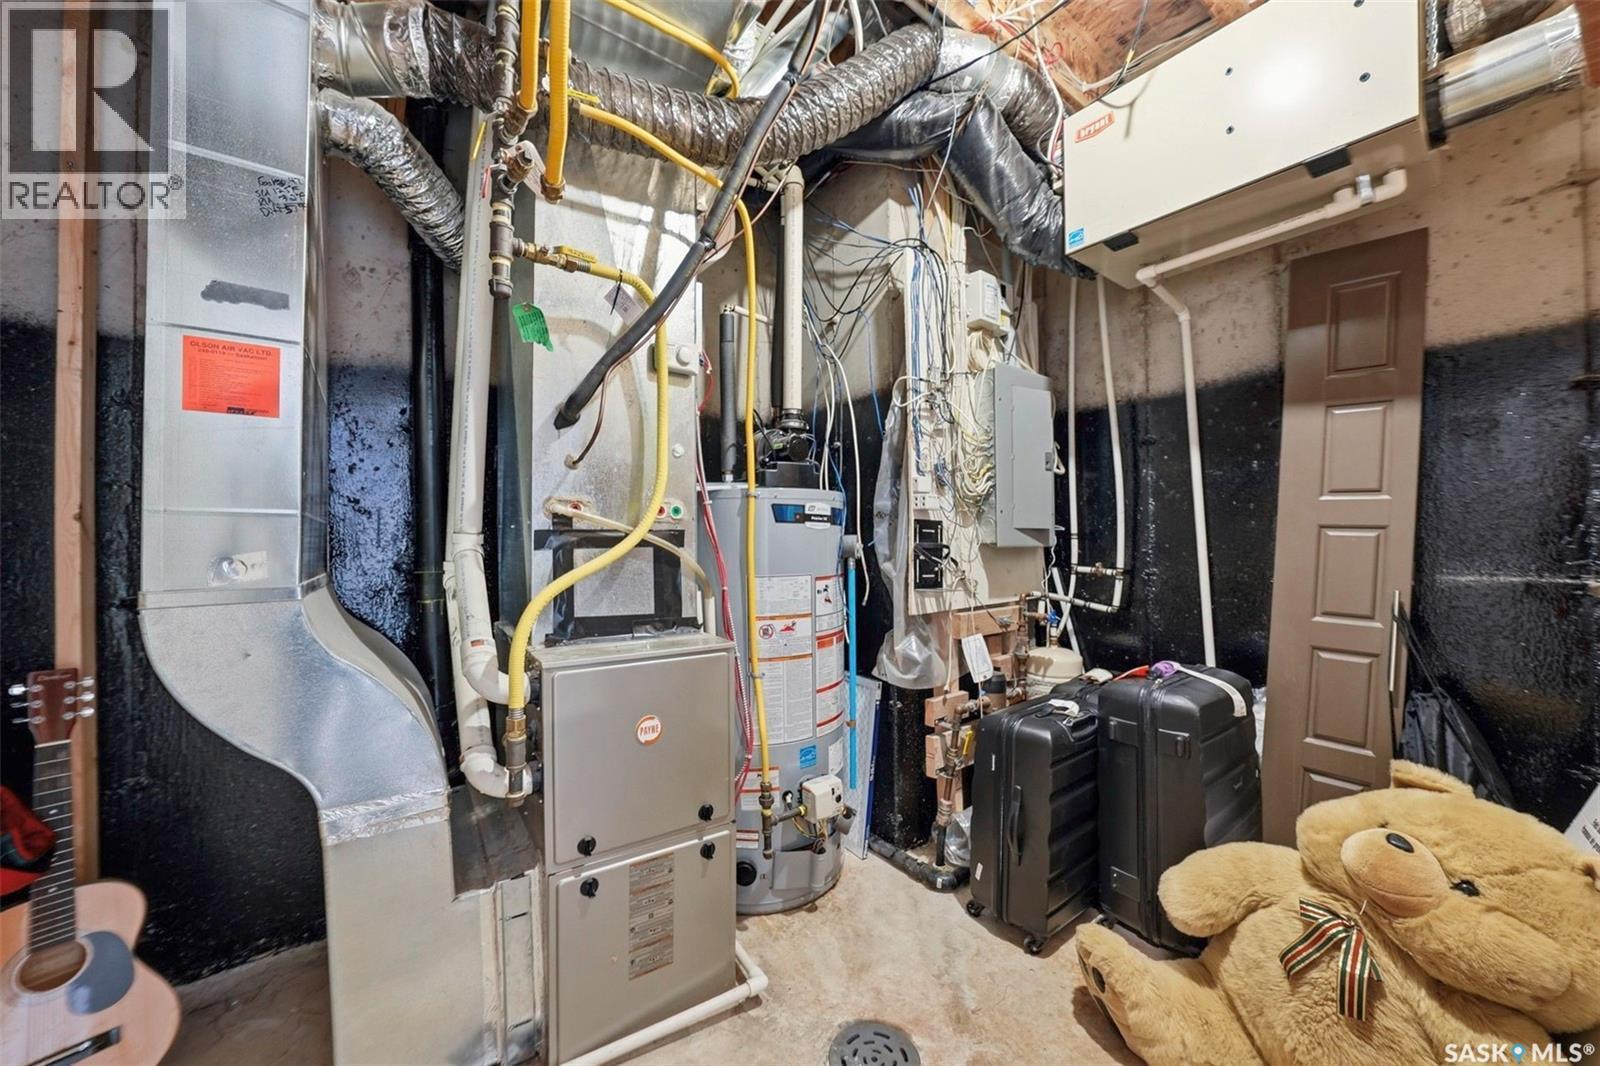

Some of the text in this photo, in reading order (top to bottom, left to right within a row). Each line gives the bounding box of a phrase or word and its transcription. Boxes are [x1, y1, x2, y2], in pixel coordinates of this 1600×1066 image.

[221, 344, 236, 352] AIR
[238, 347, 254, 355] VAC
[640, 724, 659, 736] PAYNE
